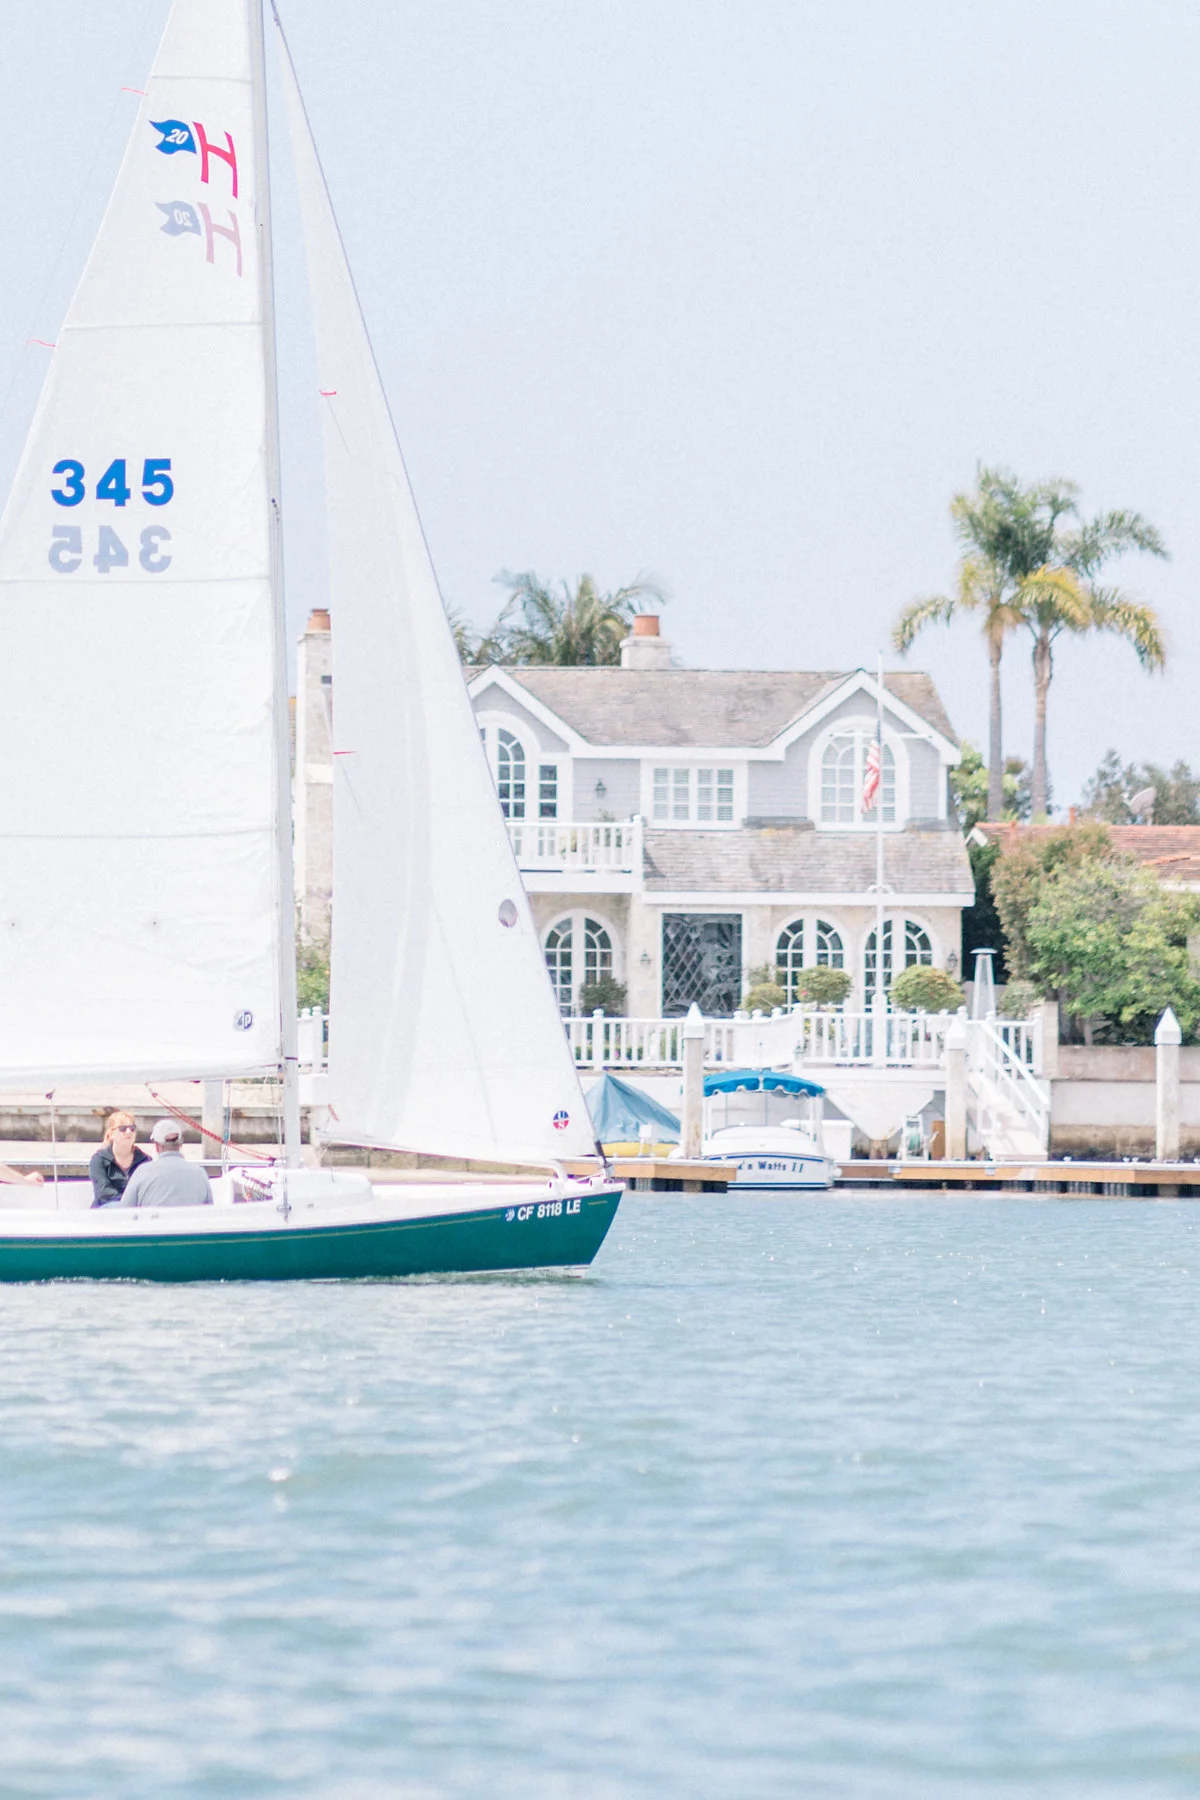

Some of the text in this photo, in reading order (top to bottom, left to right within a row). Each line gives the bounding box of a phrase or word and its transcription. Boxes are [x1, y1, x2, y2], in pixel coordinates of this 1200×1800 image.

[165, 121, 238, 199] 20 H
[51, 458, 174, 506] 345
[758, 1161, 786, 1171] Watts
[517, 1200, 581, 1221] CF 8118 LE
